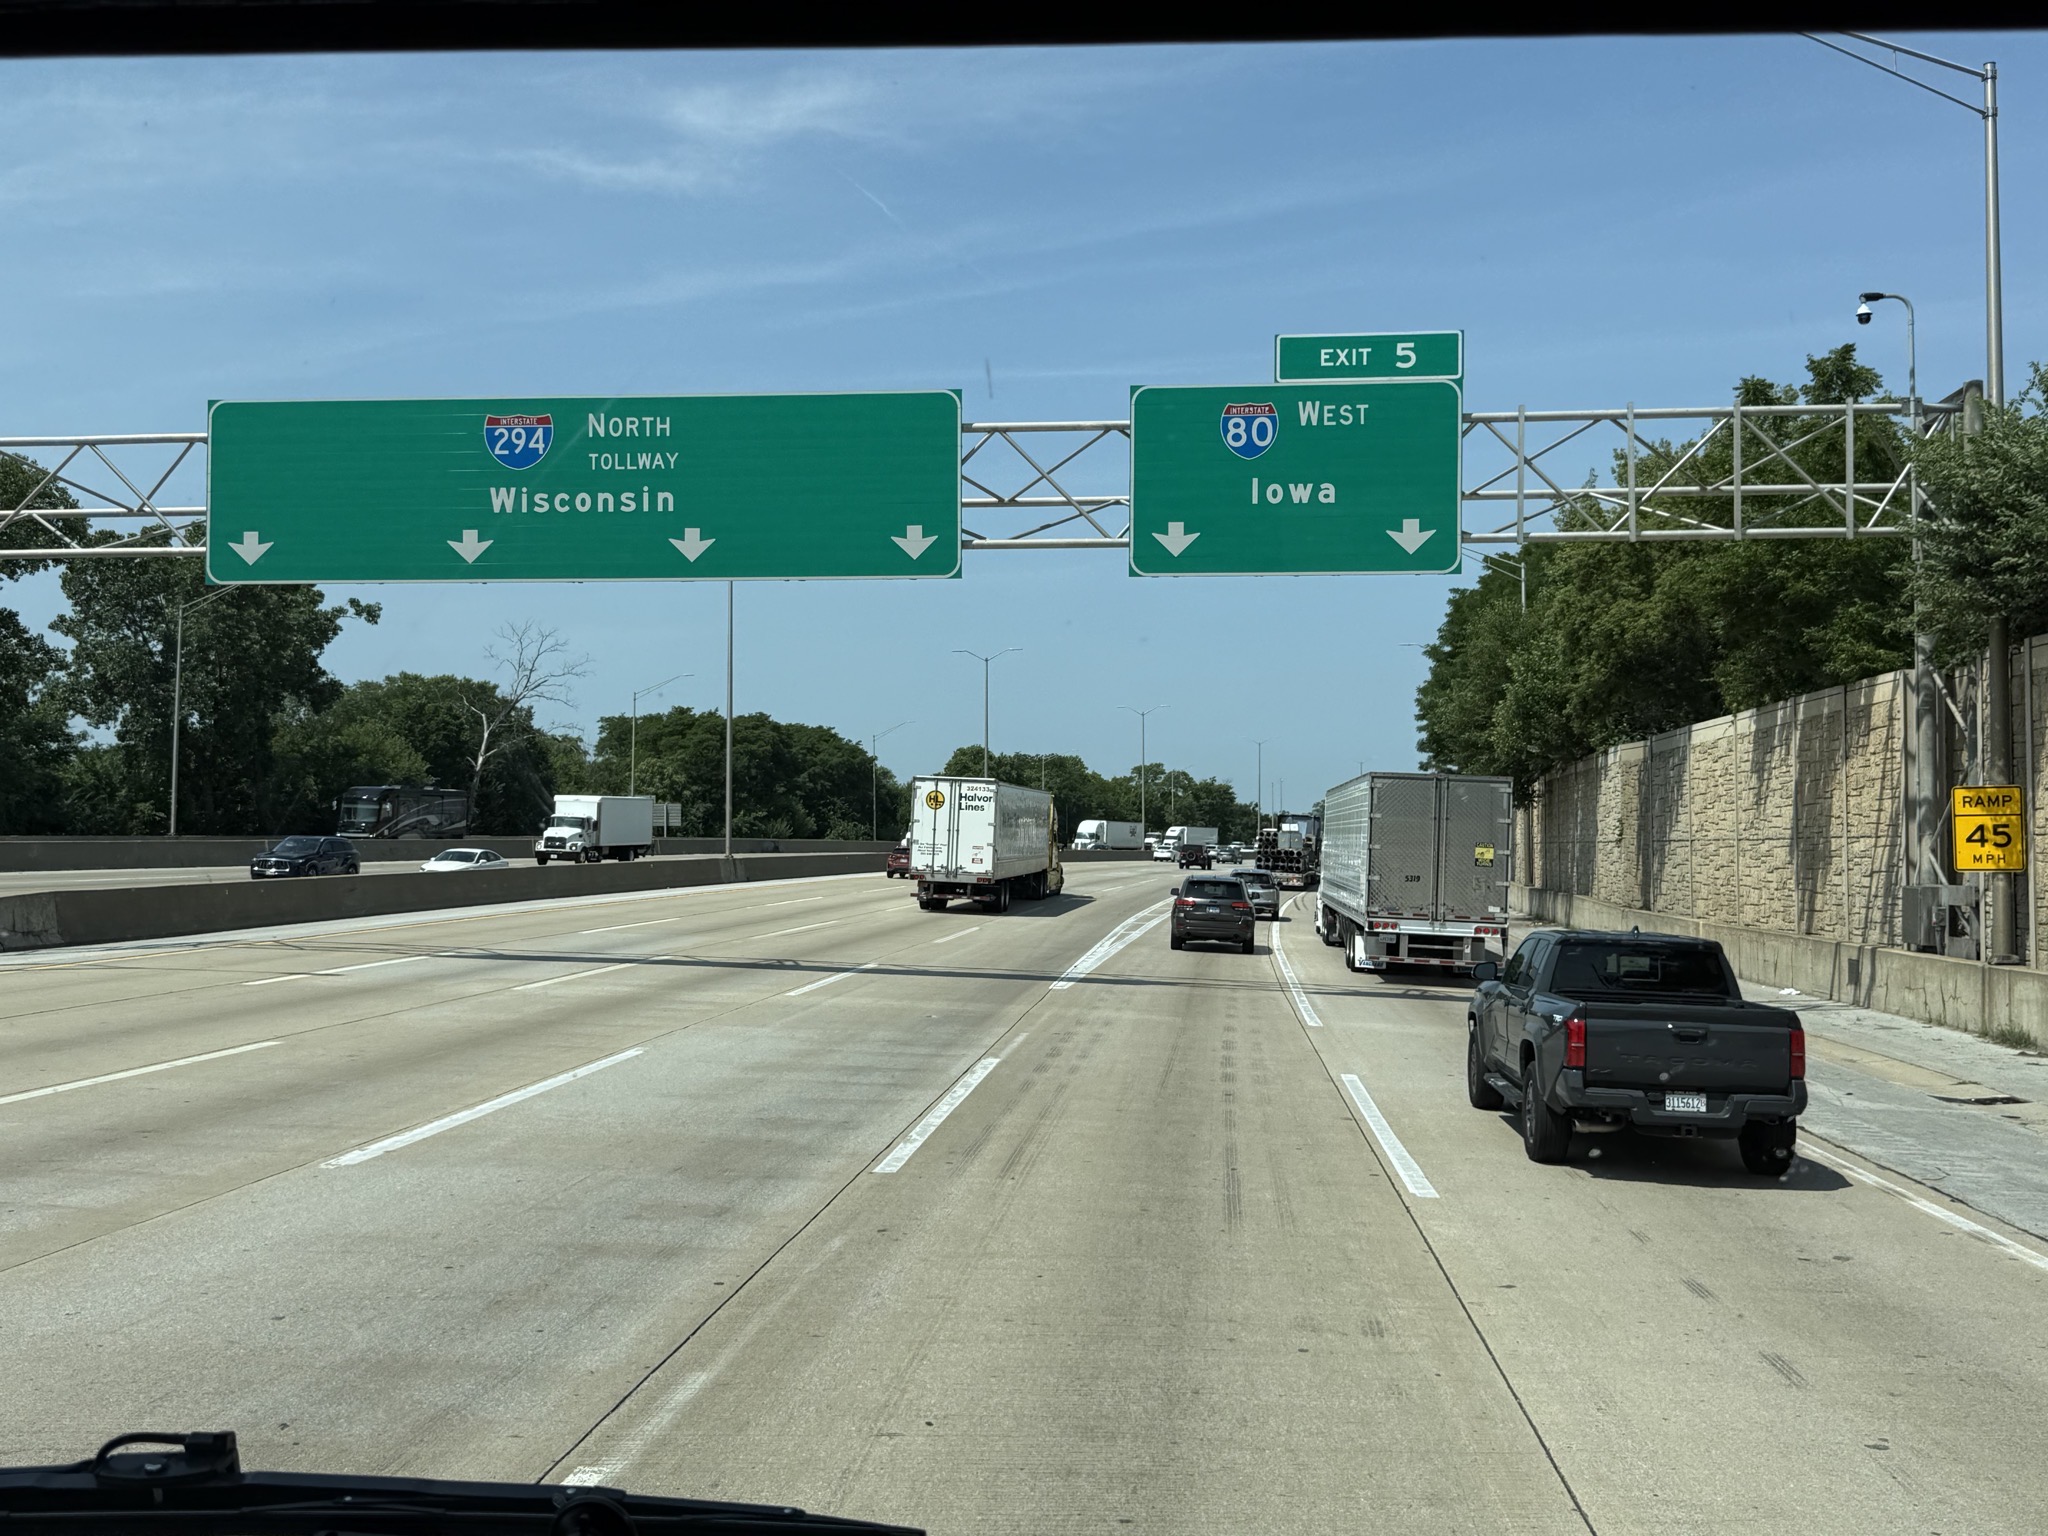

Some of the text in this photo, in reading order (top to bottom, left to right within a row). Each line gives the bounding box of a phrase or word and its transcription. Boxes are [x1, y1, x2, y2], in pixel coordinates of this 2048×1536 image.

[1320, 342, 1417, 369] EXIT 5
[1230, 406, 1270, 415] INTERSTATE
[1298, 401, 1369, 426] WEST
[500, 417, 538, 426] INTERSTATE
[588, 413, 671, 438] NORTH
[494, 427, 545, 455] 294
[1226, 416, 1274, 448] 80
[589, 452, 679, 471] TOLLWAY
[489, 485, 675, 514] Wisconsin
[1252, 477, 1336, 505] Iowa
[959, 802, 985, 812] Lines
[960, 792, 993, 803] Halvor
[1962, 794, 2013, 809] RAMP
[1965, 823, 2013, 849] 45
[1972, 853, 2007, 864] MPH
[1404, 875, 1421, 883] 5319
[1665, 1096, 1701, 1109] 3115612
